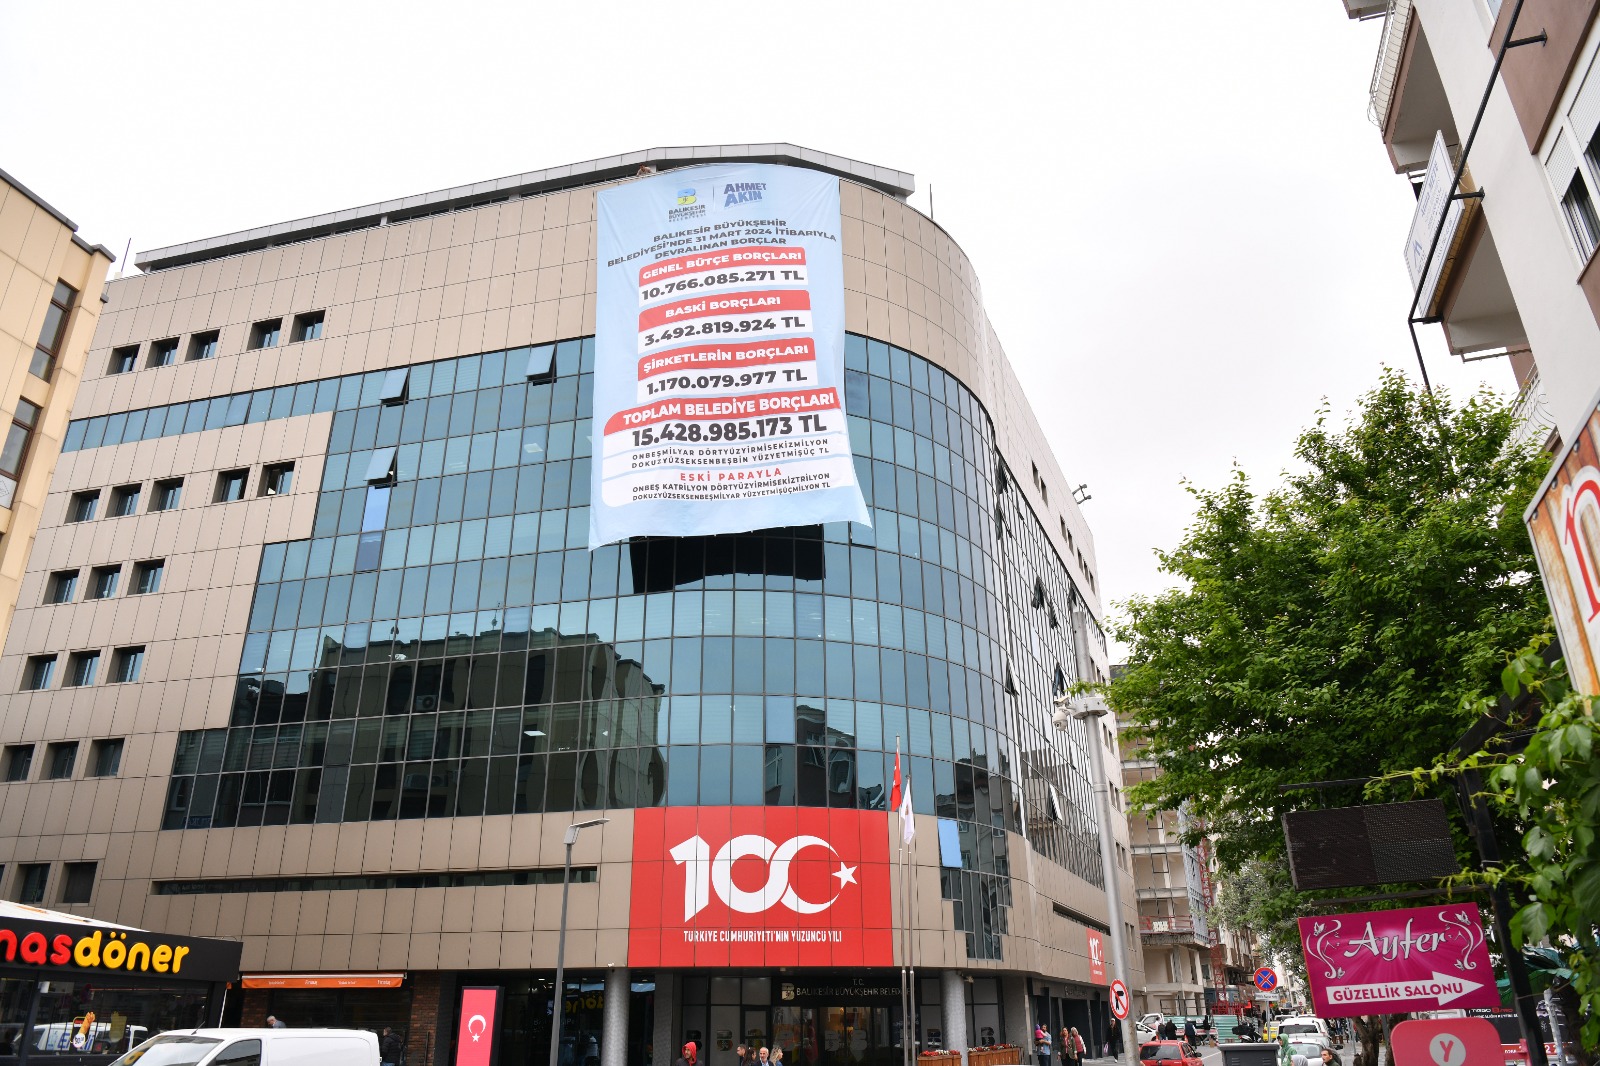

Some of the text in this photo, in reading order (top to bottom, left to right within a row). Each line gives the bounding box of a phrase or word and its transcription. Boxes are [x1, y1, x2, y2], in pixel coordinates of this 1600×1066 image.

[724, 182, 767, 195] AHMET
[724, 190, 763, 208] AKIN
[653, 218, 787, 242] BALIKESİR BÜYÜKŞEHİR
[607, 227, 837, 268] BELEDİYESİ'NDE 31 MART 2024 İTİBARIYLA
[654, 237, 787, 260] DEVRALINAN BORÇLAR
[642, 252, 802, 280] GENEL BÜTÇE BORÇLARI
[641, 270, 805, 301] 10.766.085.271 TL
[665, 296, 781, 318] BASKİ BORÇLARI
[644, 316, 806, 347] 3.492.819.924 TL
[643, 344, 809, 374] ŞİRKETLERİN BORÇLARI
[646, 369, 808, 396] 1.170.079.977 TL
[622, 392, 835, 426] TOPLAM BELEDİYE BORÇLARI
[632, 413, 828, 447] 15.428.985.173 TL
[631, 456, 749, 469] DOKUZYÜZSEKSENBEŞBİN
[752, 447, 815, 462] YÜZYETMİŞÜÇ
[632, 438, 828, 460] ONBEŞMİLYAR DÖRTYÜZYİRMİSEKİZMİLYON
[632, 472, 830, 493] ONBEŞ KATRİLYON DÖRTYÜZYİRMİSEKİZTRİLYON
[680, 467, 782, 482] ESKİ PARAYLA
[683, 930, 842, 942] TÜRKİYE CUMHURİYETİ'NİN YÜZÜNCÜ YILI
[1343, 917, 1447, 962] Ayfer
[1332, 982, 1464, 1001] GÜZELLİK SALONU
[1439, 1039, 1454, 1063] Y
